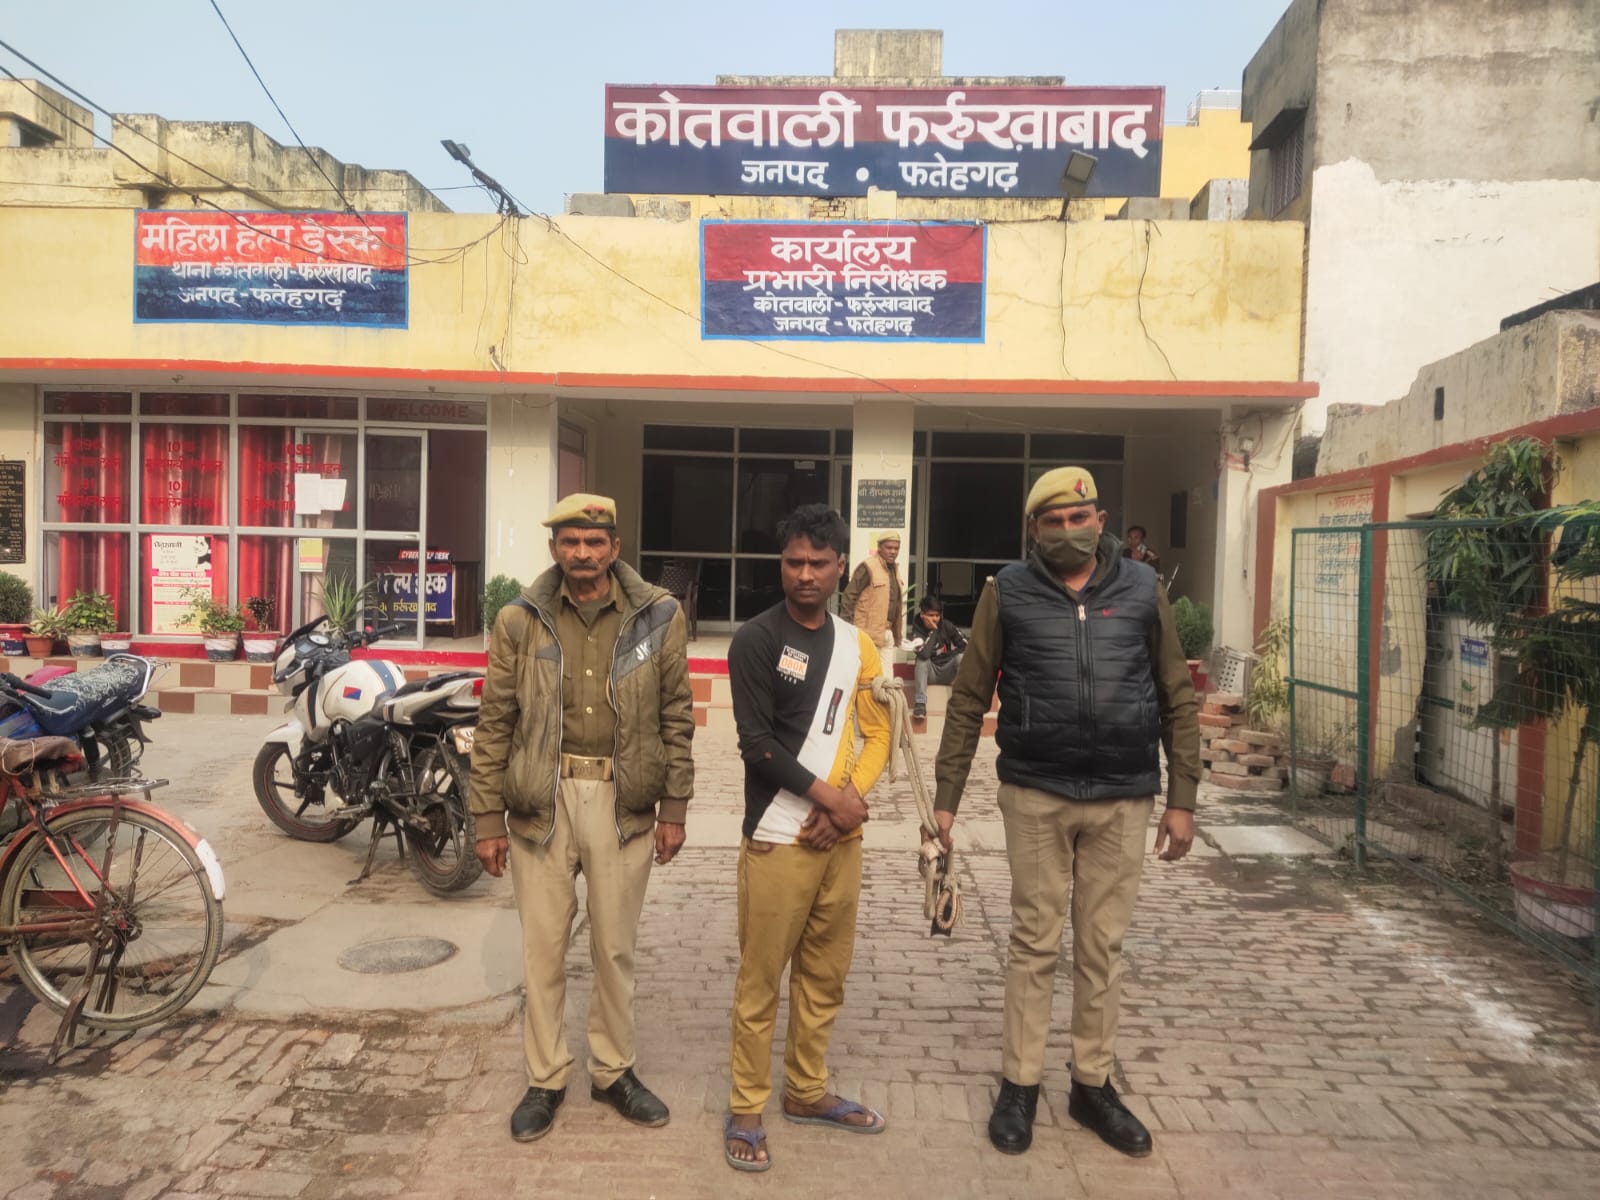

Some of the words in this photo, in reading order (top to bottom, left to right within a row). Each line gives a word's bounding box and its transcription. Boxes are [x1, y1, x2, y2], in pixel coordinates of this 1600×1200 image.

[612, 90, 862, 149] कोतवाली
[741, 160, 829, 189] जनपद
[899, 152, 1019, 192] फतेहगढ़
[142, 216, 230, 256] महिला
[235, 216, 296, 257] हेल्प
[301, 217, 387, 255] डेस्क
[770, 229, 917, 266] कार्यालय
[171, 261, 212, 279] थाना
[742, 263, 836, 293] प्रभारी
[840, 263, 947, 295] निरीक्षक
[177, 287, 241, 307] जनपद
[249, 283, 347, 312] फतेहगढ़
[753, 291, 835, 314] कोतवाली
[773, 317, 831, 335] जनपद
[845, 311, 915, 336] फतेहगढ़
